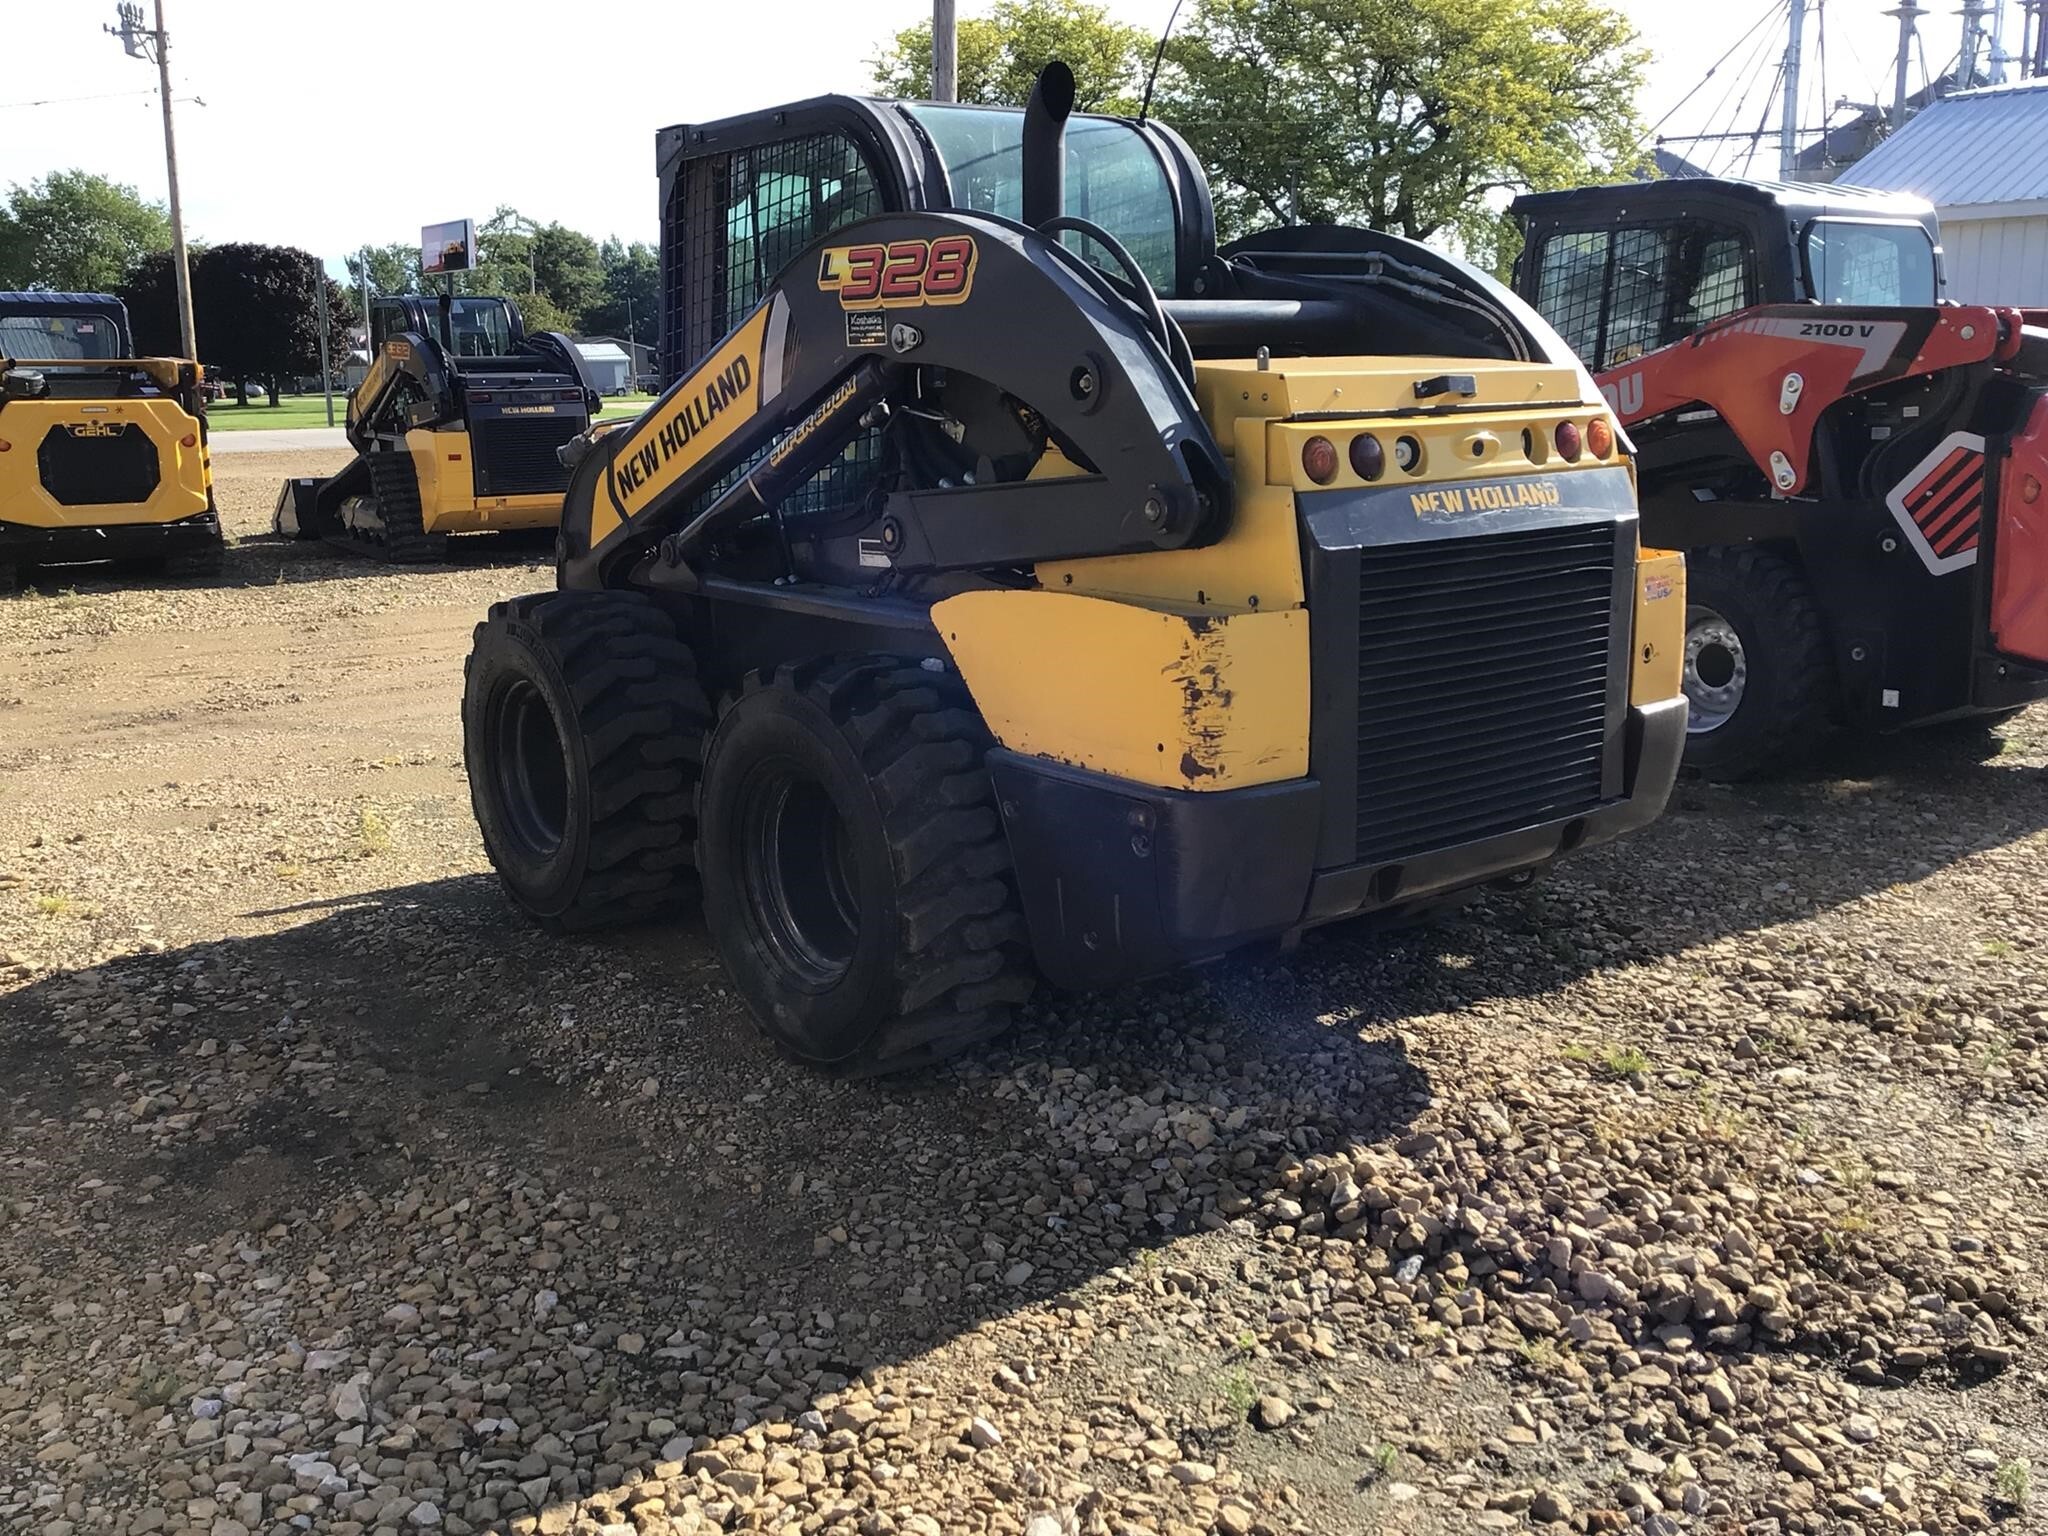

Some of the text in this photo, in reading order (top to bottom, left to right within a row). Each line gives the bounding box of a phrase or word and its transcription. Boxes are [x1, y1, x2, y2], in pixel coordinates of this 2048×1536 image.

[819, 237, 975, 304] L328
[1800, 323, 1874, 338] 2100 V
[75, 426, 117, 436] GEHL
[617, 354, 751, 500] NEW HOLLAND
[770, 374, 857, 467] SUPER BOOM
[1410, 482, 1560, 520] NEW HOLLAND
